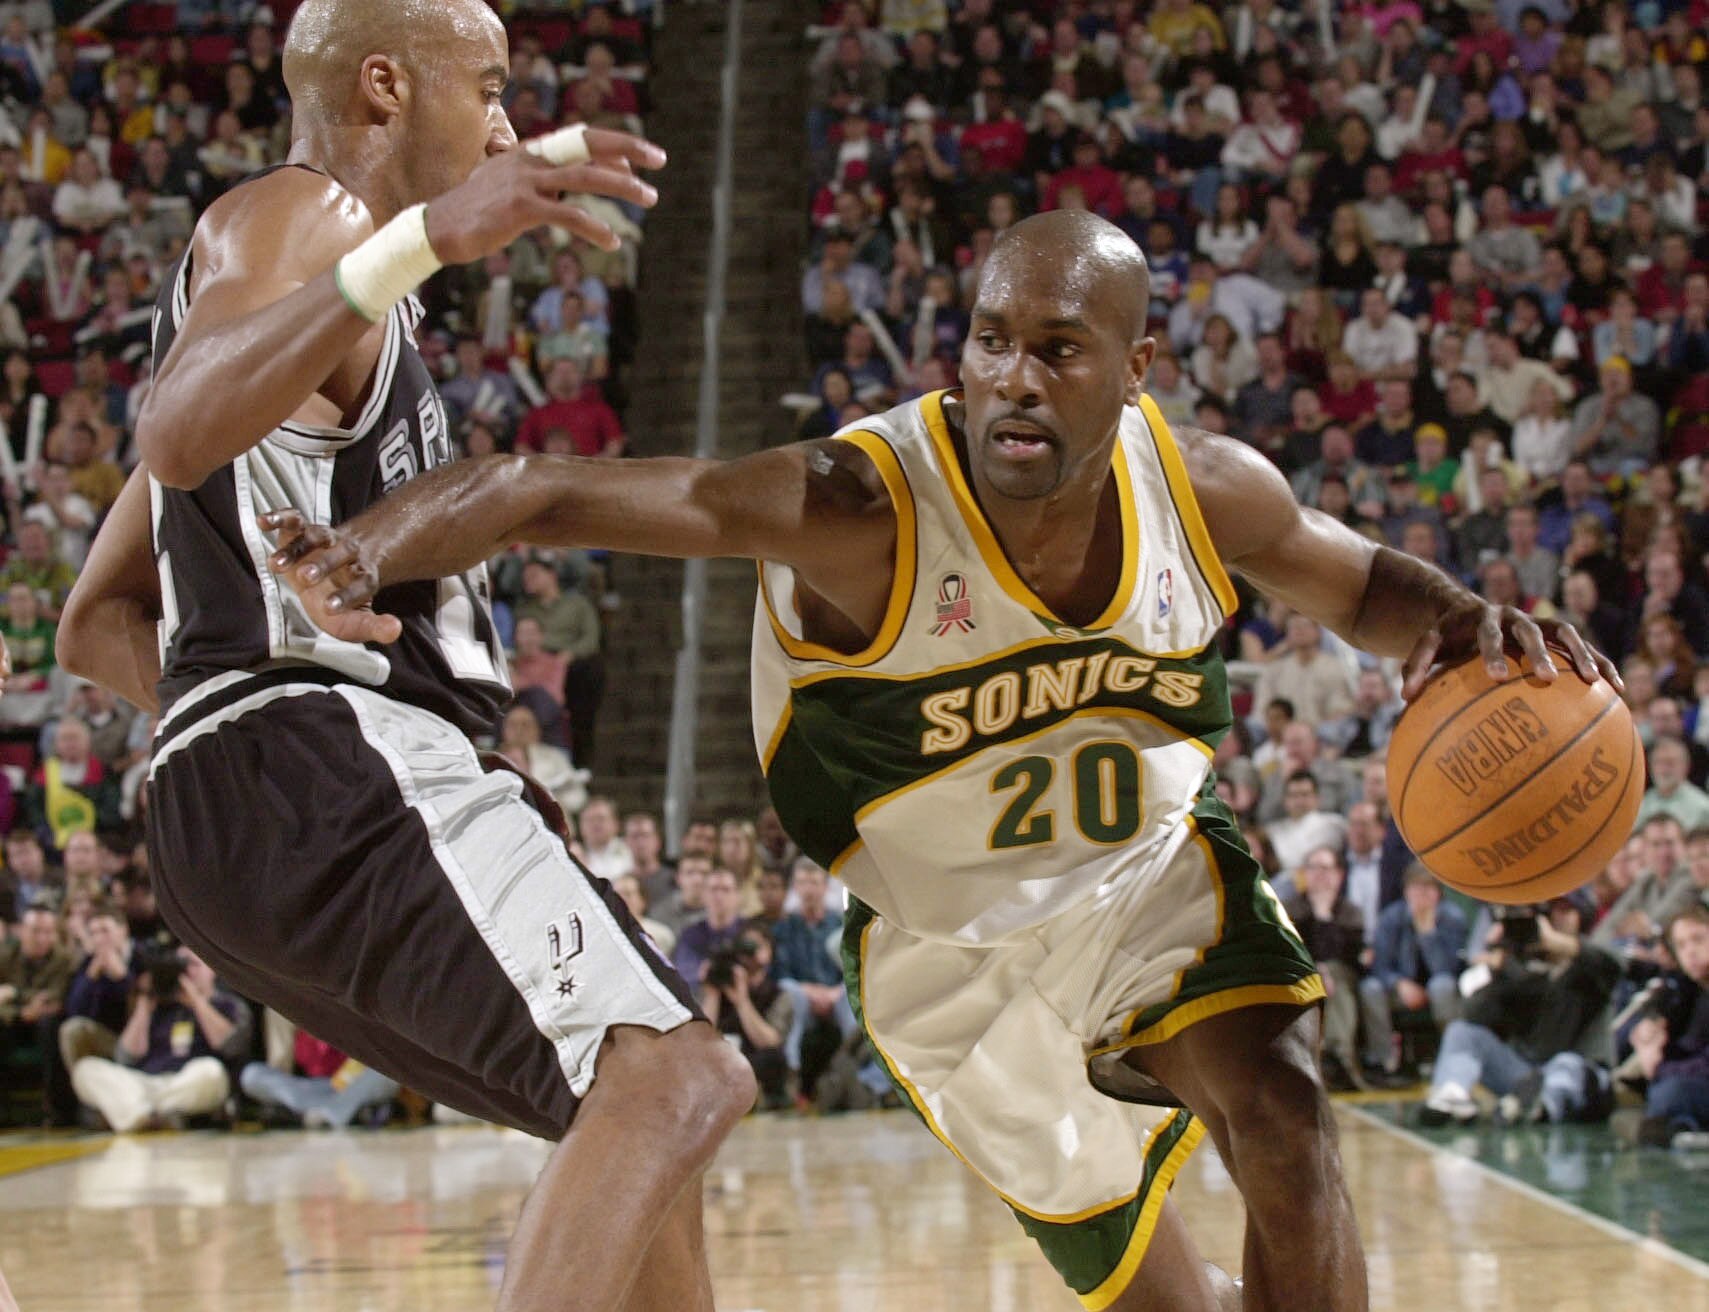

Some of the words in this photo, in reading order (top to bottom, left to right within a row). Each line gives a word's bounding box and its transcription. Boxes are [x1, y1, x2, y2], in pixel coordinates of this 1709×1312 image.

[920, 650, 1203, 755] SONICS
[1435, 709, 1528, 797] NBA
[987, 738, 1144, 851] 20
[1464, 747, 1618, 877] SPALDING
